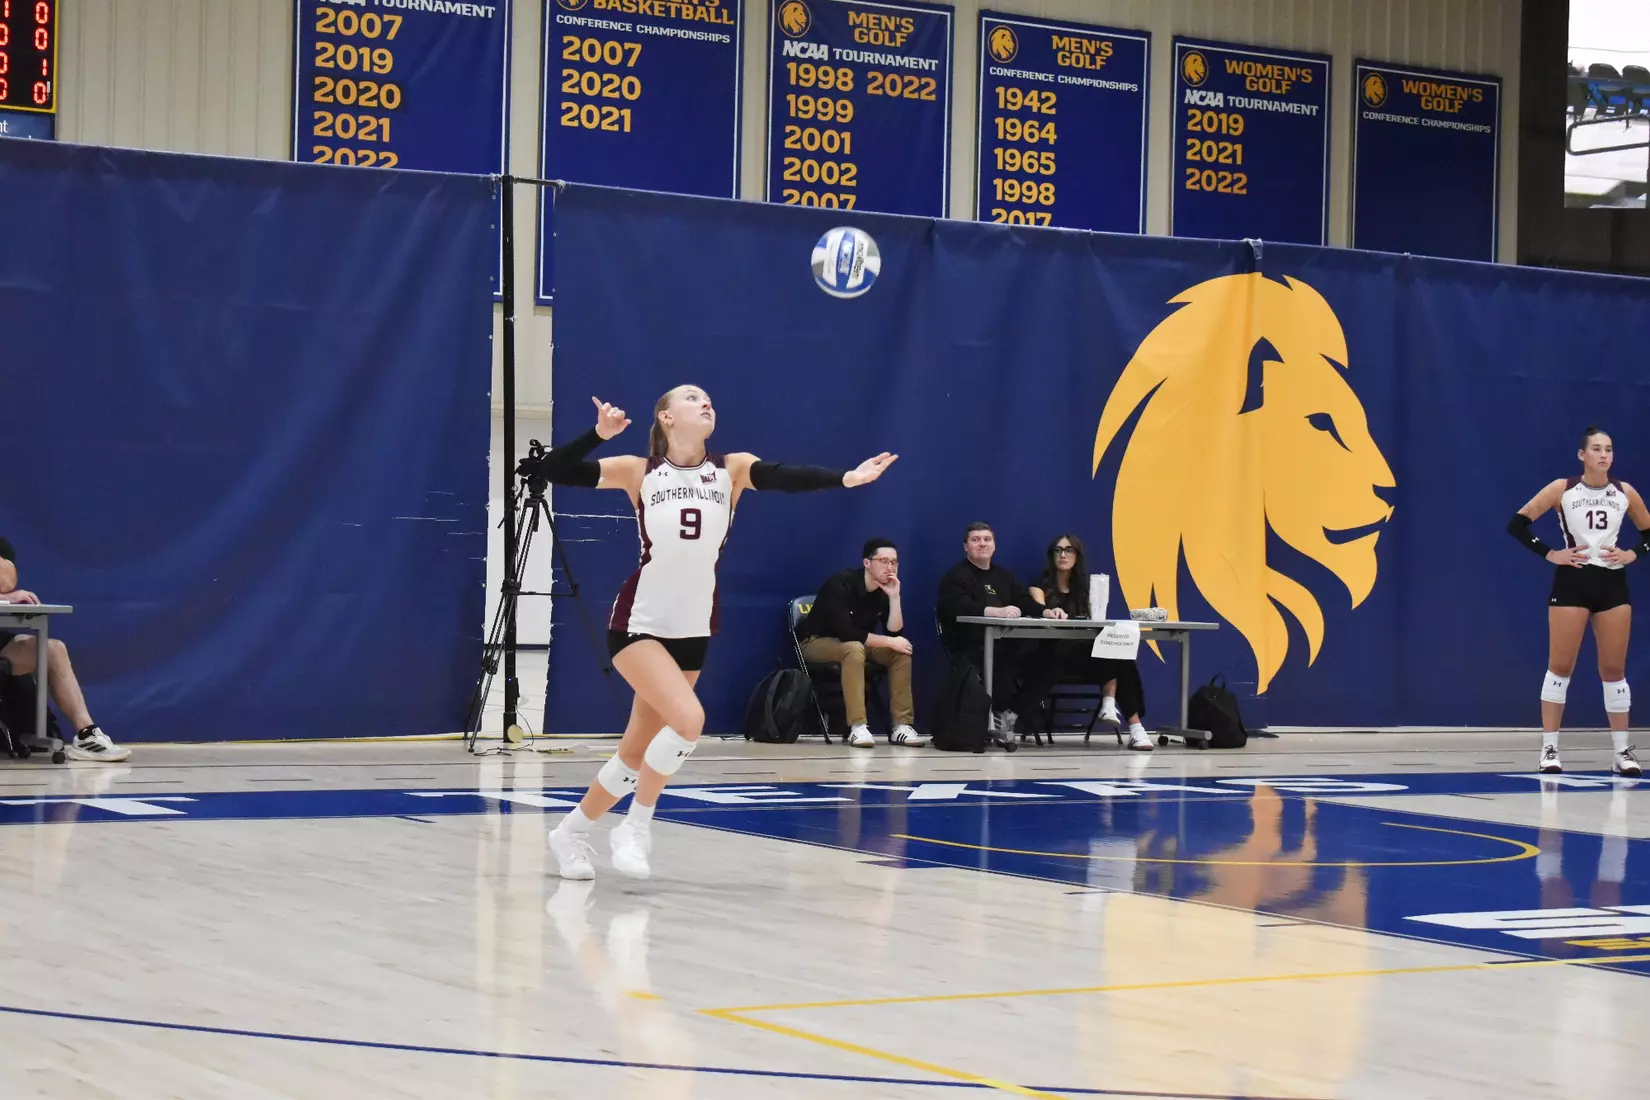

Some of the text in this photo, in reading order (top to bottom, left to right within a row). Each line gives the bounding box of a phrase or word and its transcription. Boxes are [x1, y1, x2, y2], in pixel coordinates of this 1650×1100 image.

[35, 1, 48, 24] 0
[316, 7, 402, 40] 2007
[593, 0, 735, 25] BASKETBALL
[848, 11, 915, 34] MEN'S
[35, 27, 48, 50] 0
[556, 14, 731, 43] CONFERENCE CHAMPIONSHIPS
[854, 27, 908, 47] GOLF
[315, 42, 393, 74] 2019
[563, 36, 642, 67] 2007
[783, 40, 938, 71] NCAA TOURNAMENT
[1052, 35, 1113, 57] MEN'S
[42, 58, 47, 76] 1
[1057, 51, 1106, 70] GOLF
[1225, 59, 1313, 83] WOMEN'S
[33, 81, 46, 104] 0
[313, 76, 401, 109] 2020
[562, 69, 642, 100] 2020
[786, 62, 937, 100] 1998 2022
[989, 66, 1138, 92] CONFERENCE CHAMPIONSHIPS
[1246, 77, 1292, 95] GOLF
[1402, 79, 1484, 103] WOMEN'S
[786, 94, 854, 123] 1999
[995, 87, 1057, 114] 1942
[1184, 89, 1319, 116] NCAA TOURNAMENT
[1421, 96, 1464, 113] GOLF
[314, 111, 390, 142] 2021
[561, 102, 631, 132] 2021
[1187, 109, 1244, 136] 2019
[1363, 111, 1491, 133] CONFERENCE CHAMPIONSHIPS
[784, 125, 851, 154] 2001
[995, 117, 1057, 145] 1964
[313, 146, 398, 169] 2022
[994, 148, 1056, 175] 1965
[1186, 138, 1243, 165] 2021
[783, 157, 857, 186] 2002
[1185, 168, 1248, 195] 2022
[783, 189, 856, 210] 2007
[993, 178, 1055, 206] 1998
[992, 208, 1052, 228] 2017
[651, 487, 694, 506] SOUTHERN
[680, 508, 702, 540] 9
[1585, 510, 1608, 530] 13
